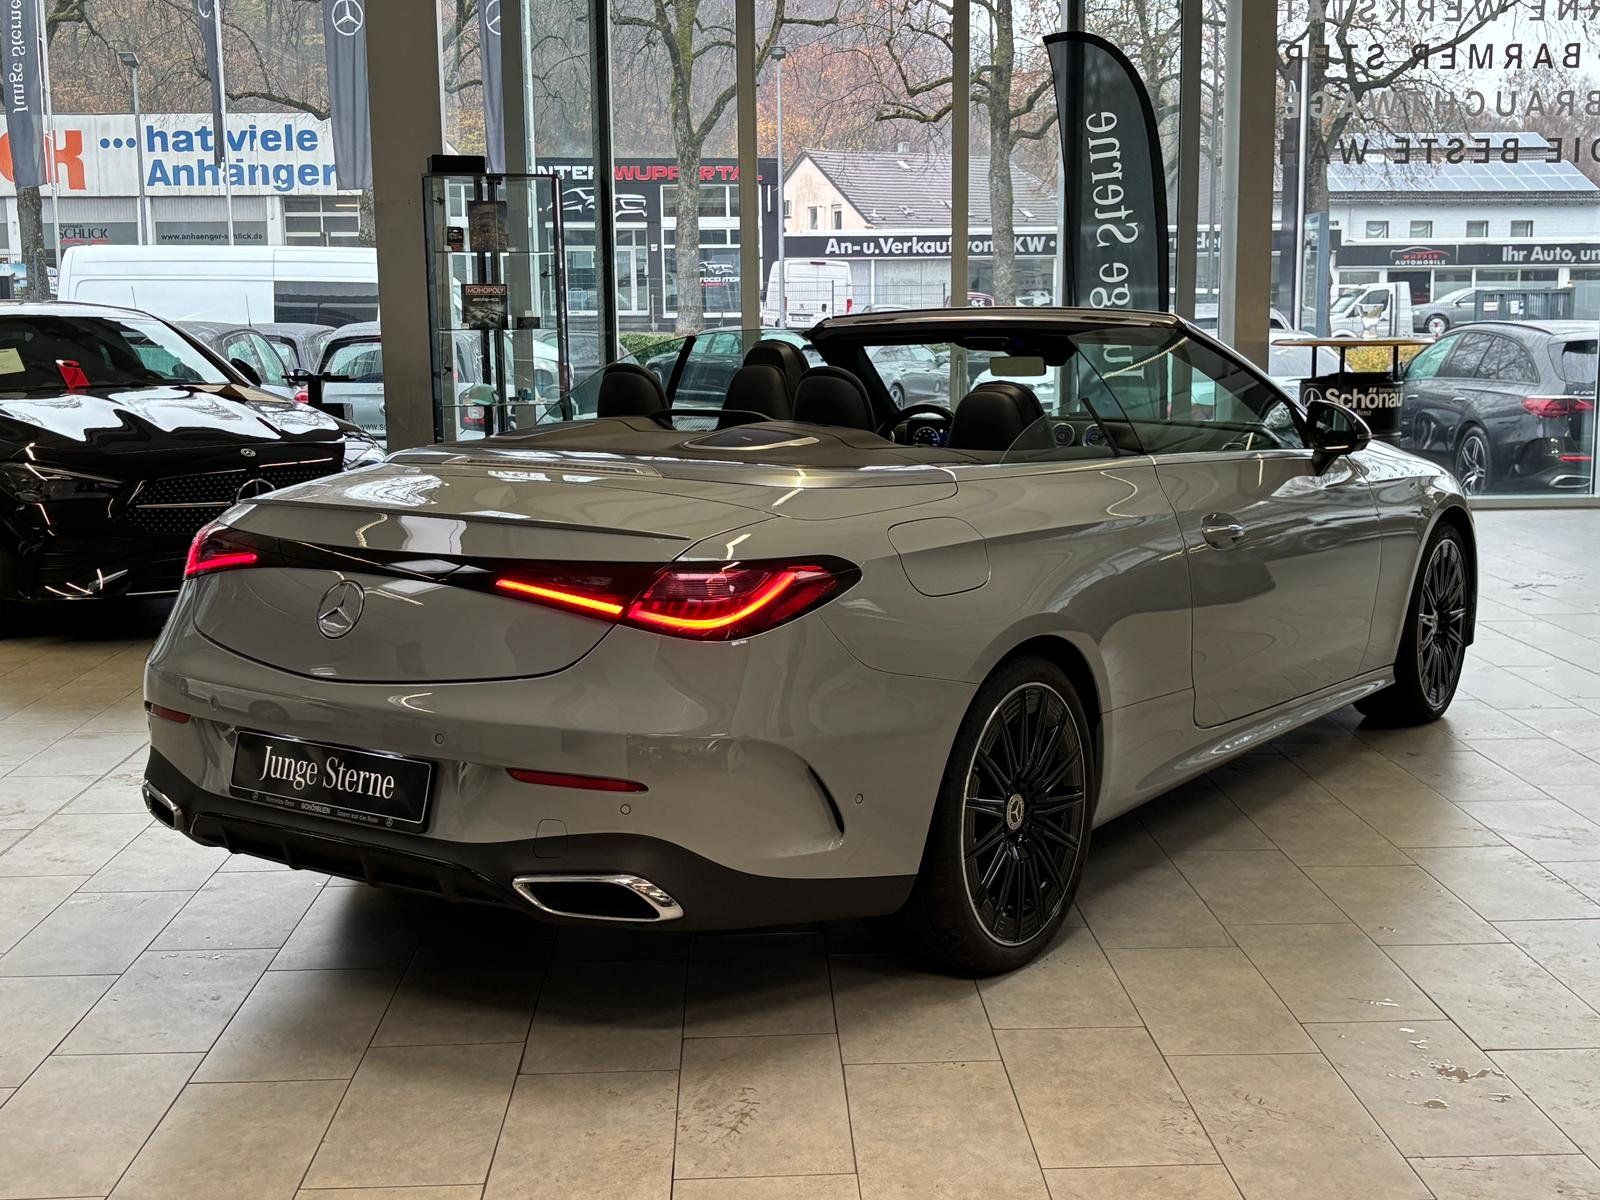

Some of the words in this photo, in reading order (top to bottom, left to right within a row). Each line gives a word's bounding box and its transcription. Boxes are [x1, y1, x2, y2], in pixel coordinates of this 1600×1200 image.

[146, 125, 214, 153] hat
[227, 124, 318, 153] viele
[147, 158, 336, 192] Anhänger
[1502, 246, 1529, 262] Ihr
[1530, 246, 1577, 263] Auto,
[467, 286, 505, 295] MONOPOLY
[1325, 387, 1403, 409] Schönau
[259, 745, 318, 791] Junge
[322, 755, 395, 800] Sterne
